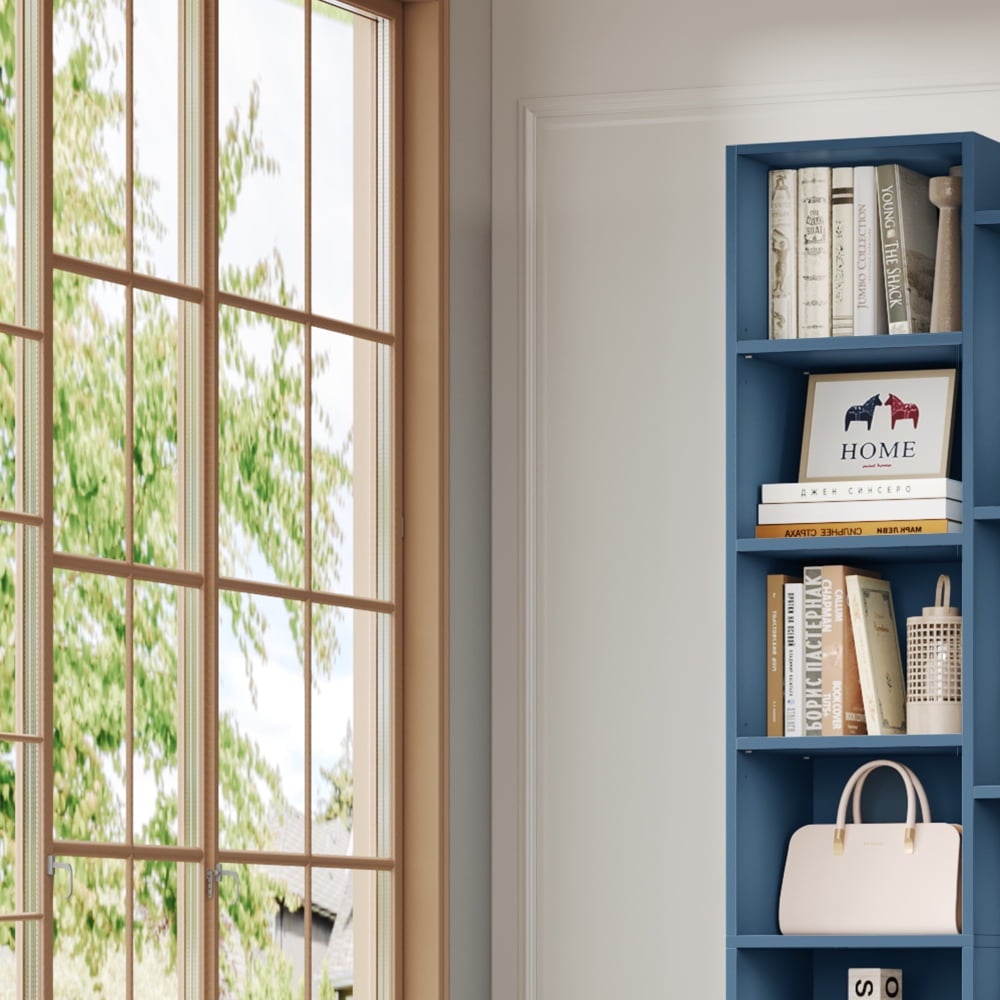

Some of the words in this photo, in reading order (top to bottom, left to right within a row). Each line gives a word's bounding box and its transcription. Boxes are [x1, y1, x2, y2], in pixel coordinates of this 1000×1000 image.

[882, 185, 896, 229] YOUNG
[857, 203, 867, 271] COLLECTION
[885, 240, 900, 265] THE
[857, 273, 869, 309] JUMBO
[887, 264, 903, 308] SHACK
[841, 441, 916, 460] HOME
[801, 488, 837, 497] ДЖЕН
[848, 485, 912, 496] СИНСЕРО
[822, 579, 833, 632] CHAPMAN
[835, 588, 844, 622] CALLUM
[805, 575, 822, 673] ПАСТЕРНАК
[805, 677, 822, 731] БОРИС
[832, 680, 842, 704] BOOK
[832, 704, 842, 729] COVER
[855, 979, 874, 997] S
[885, 976, 899, 998] O
